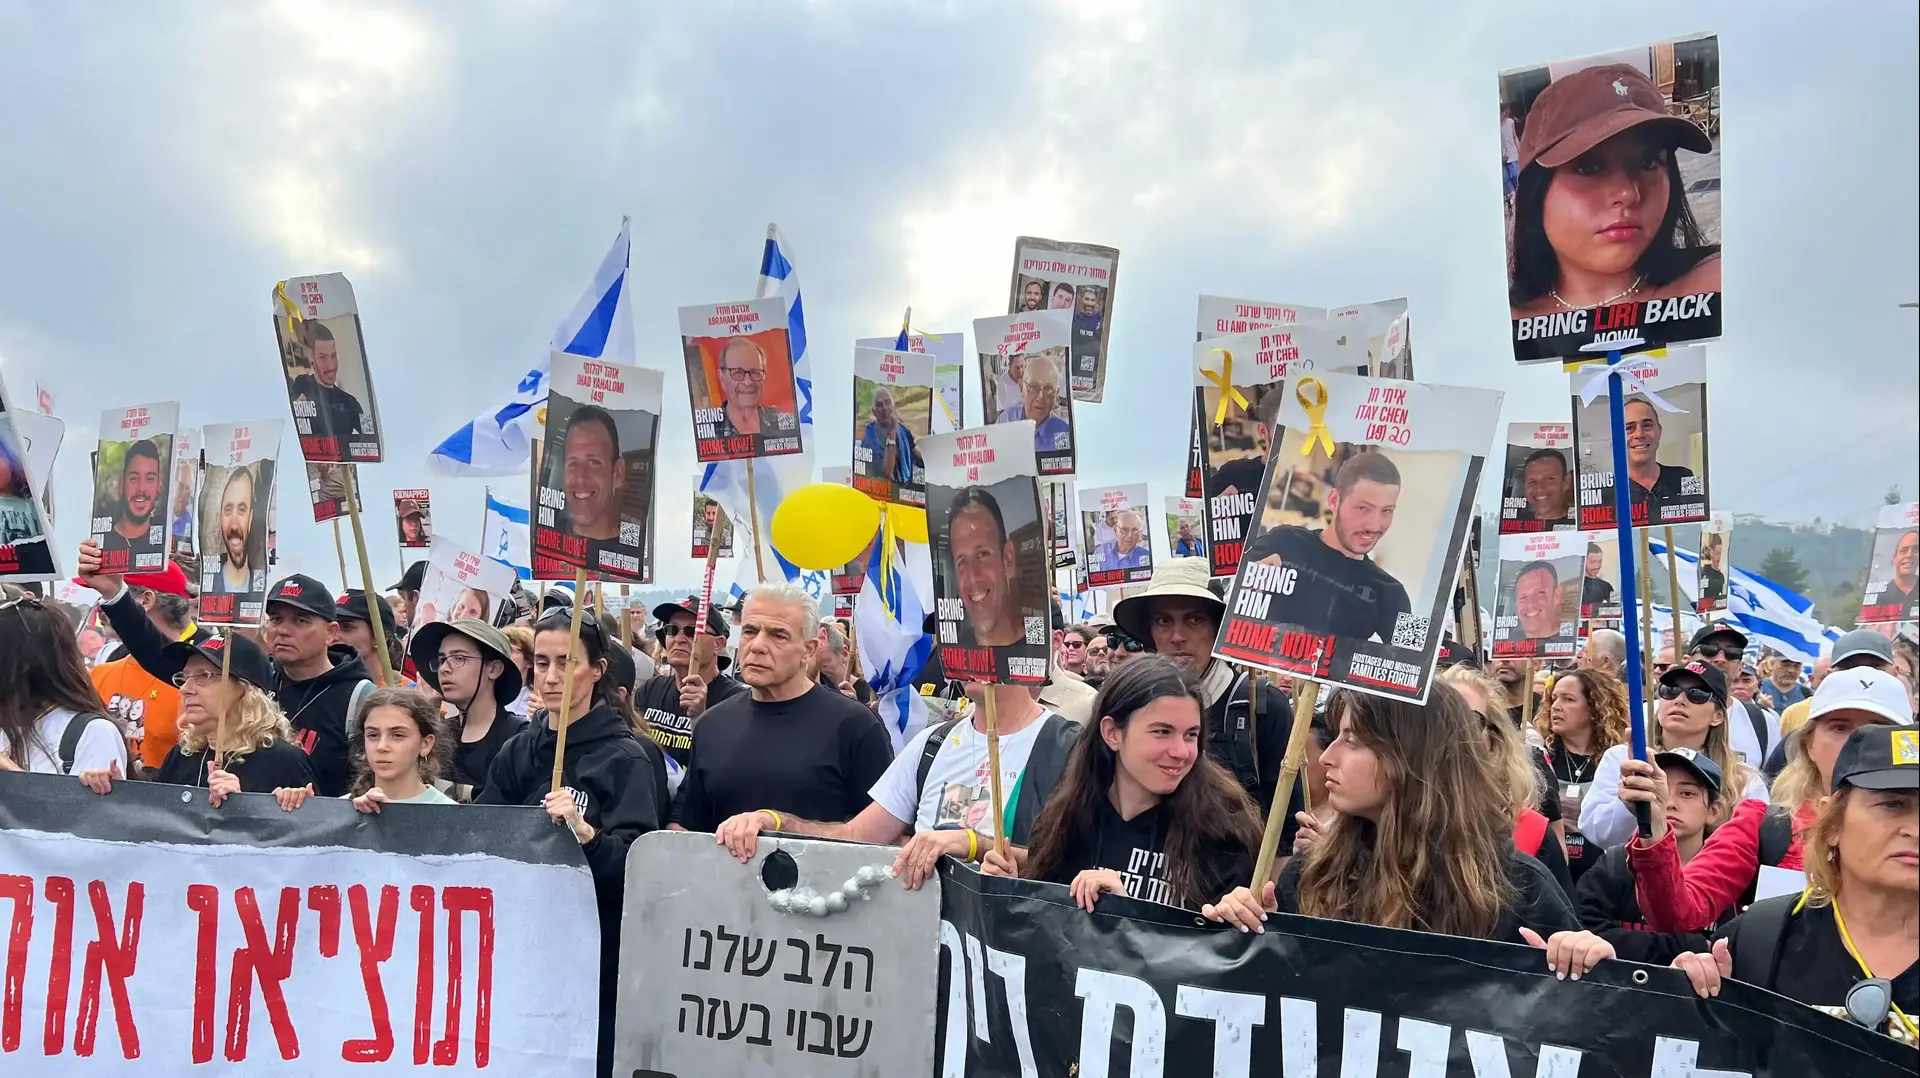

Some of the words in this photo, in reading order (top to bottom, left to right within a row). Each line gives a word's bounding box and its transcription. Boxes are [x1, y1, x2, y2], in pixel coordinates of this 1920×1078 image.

[708, 316, 736, 326] ABRAHAM
[736, 312, 760, 323] MUNDER
[1235, 304, 1261, 319] שרעבי
[1283, 310, 1296, 323] אלי
[1517, 310, 1587, 341] BRING
[1593, 301, 1640, 332] LIRI
[1644, 292, 1713, 324] BACK
[1216, 318, 1229, 332] ELI
[1230, 319, 1247, 333] AND
[1021, 330, 1041, 341] COOPER
[1259, 335, 1270, 350] חן
[1271, 332, 1292, 348] איתי
[1255, 350, 1273, 365] ITAY
[1276, 346, 1299, 362] CHEN
[604, 365, 620, 379] אוהד
[1642, 367, 1659, 379] IDAN
[576, 374, 592, 388] OHAD
[592, 377, 625, 394] YAHALOMI
[590, 390, 604, 404] (49)
[1367, 387, 1379, 403] חן
[1382, 390, 1406, 406] איתי
[695, 407, 724, 424] BRING
[1355, 404, 1379, 420] ITAY
[1379, 407, 1409, 425] CHEN
[697, 423, 716, 439] HIM
[1389, 426, 1411, 445] 20
[698, 438, 726, 455] HOME
[727, 435, 755, 452] NOW!
[854, 445, 873, 462] BRING
[953, 452, 966, 468] OHAD
[967, 448, 996, 465] YAHALOMI
[1580, 472, 1614, 490] BRING
[394, 489, 428, 499] KIDNAPPED
[540, 486, 566, 510] BRING
[1504, 497, 1527, 509] BRING
[1581, 489, 1602, 506] HIM
[1211, 492, 1255, 519] BRING
[1503, 508, 1518, 519] HIM
[1661, 509, 1684, 519] FAMILIES
[1685, 507, 1705, 517] FORUM
[538, 505, 555, 528] HIM
[1580, 506, 1612, 524] HOME
[92, 516, 113, 533] BRING
[1212, 517, 1241, 541] HIM
[1501, 520, 1523, 532] HOME
[536, 527, 561, 549] HOME
[563, 534, 588, 559] NOW!
[1242, 561, 1298, 596] BRING
[937, 597, 965, 621] BRING
[1234, 589, 1272, 620] HIM
[1497, 616, 1518, 628] BRING
[939, 621, 959, 644] HIM
[1495, 628, 1509, 640] HIM
[1225, 618, 1280, 655] HOME
[1279, 630, 1335, 666] NOW!
[1494, 641, 1515, 653] HOME
[1516, 638, 1537, 652] NOW!
[941, 647, 968, 671] HOME
[968, 647, 996, 673] NOW!
[1352, 652, 1382, 667] HOSTAGES
[1381, 658, 1394, 669] AND
[1393, 660, 1421, 675] MISSING
[1350, 662, 1387, 681] FAMILIES
[1385, 670, 1419, 689] FORUM
[682, 925, 778, 978] שלנו
[783, 933, 874, 993] הלב
[187, 884, 495, 1068] תוציאו
[678, 993, 772, 1047] בעזה
[786, 1008, 873, 1059] שבוי
